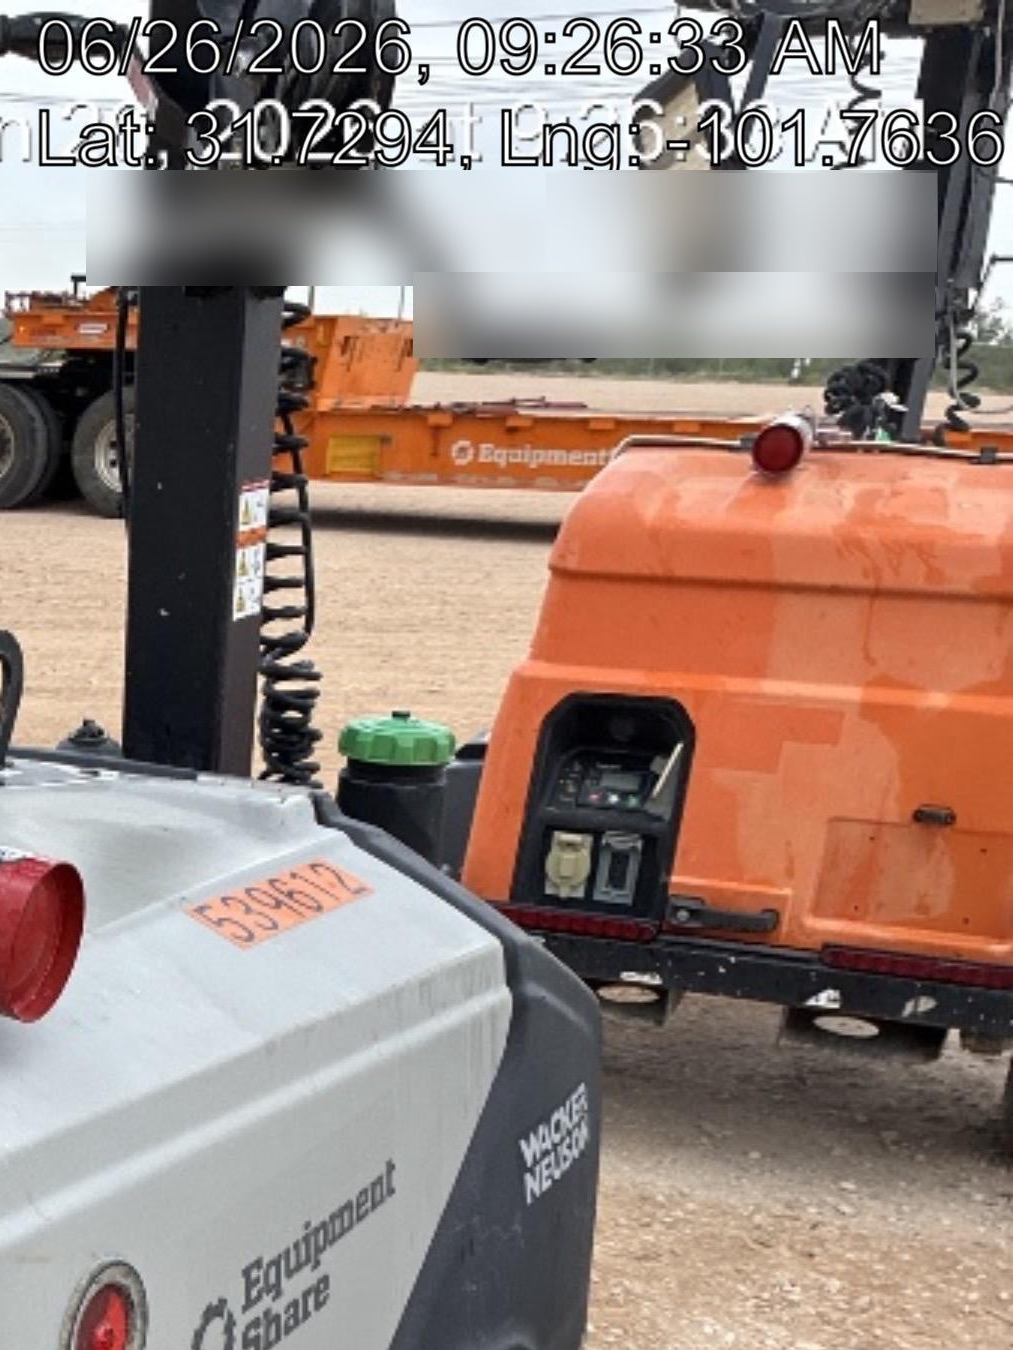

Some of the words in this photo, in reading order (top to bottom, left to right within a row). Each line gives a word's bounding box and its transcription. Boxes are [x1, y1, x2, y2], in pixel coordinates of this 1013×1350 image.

[194, 862, 368, 943] 539612
[518, 1081, 589, 1169] WACKER
[523, 1120, 589, 1206] NEUSON
[241, 1157, 396, 1315] Equipment
